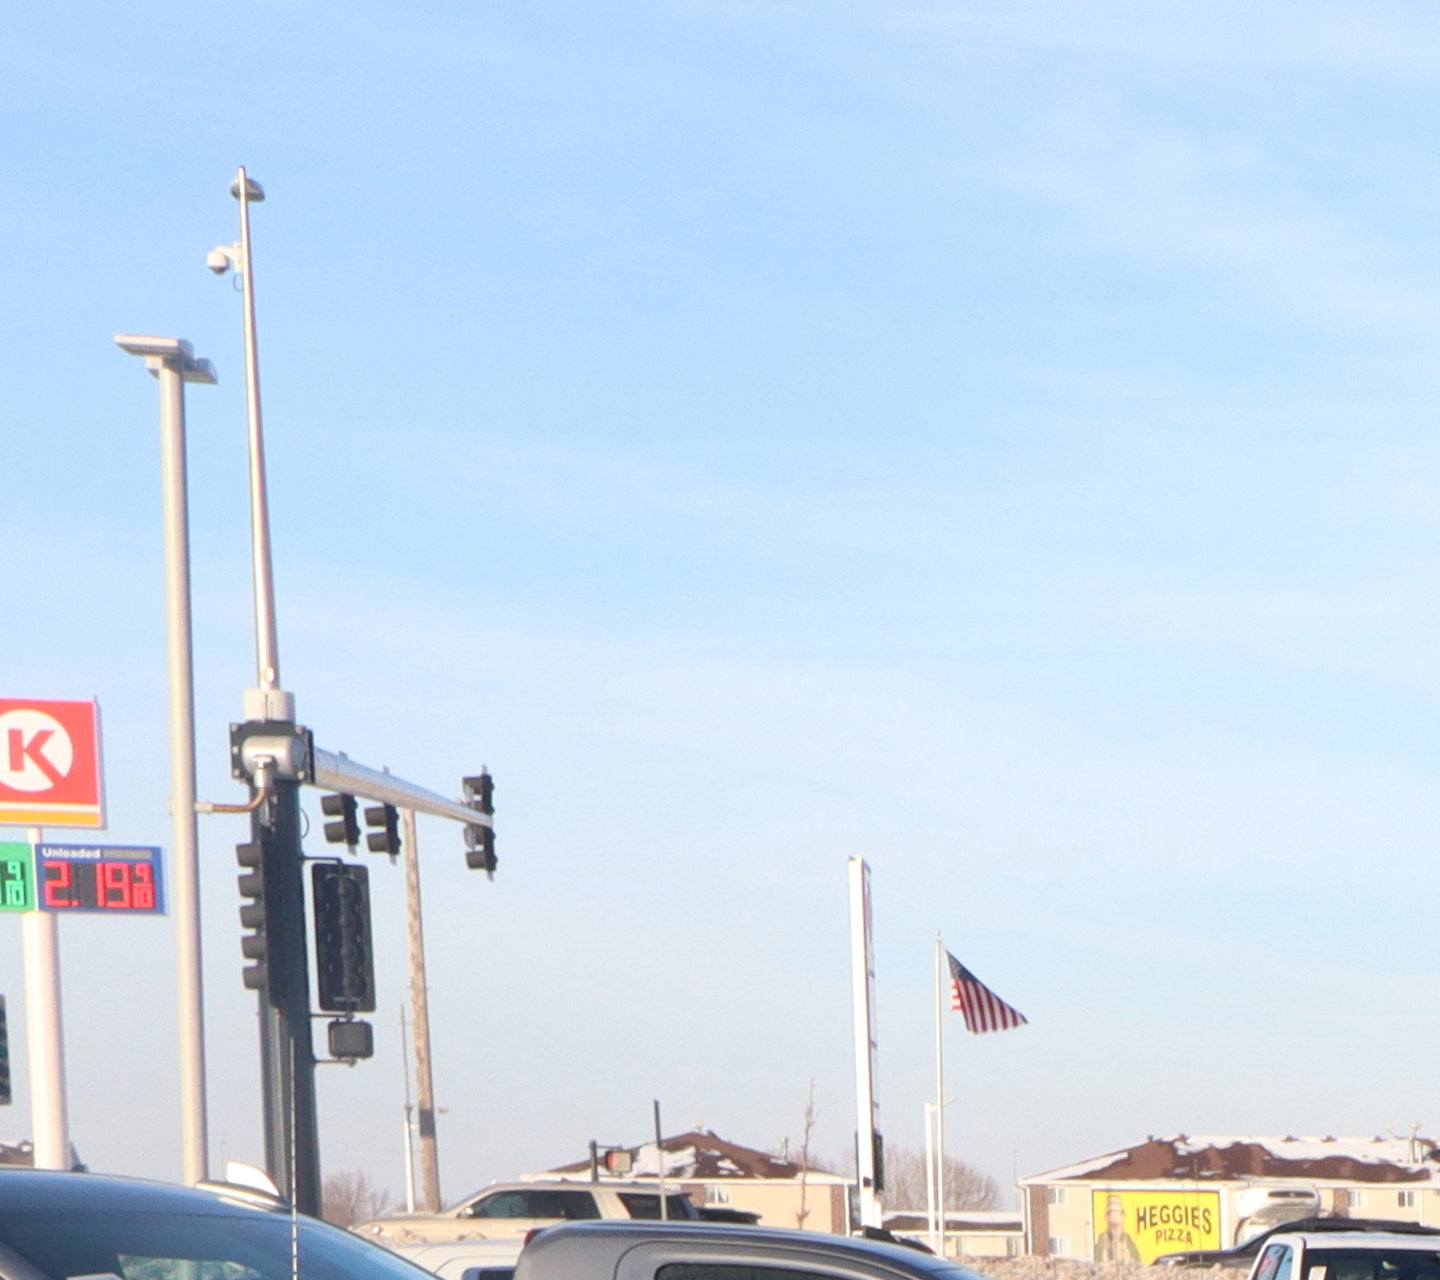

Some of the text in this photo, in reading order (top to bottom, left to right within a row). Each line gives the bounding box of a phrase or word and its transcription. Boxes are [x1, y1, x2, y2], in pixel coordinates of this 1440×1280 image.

[8, 728, 68, 778] K
[42, 847, 101, 858] Unleaded
[1136, 1204, 1212, 1235] HEGGIES
[1156, 1228, 1193, 1245] PIZZA
